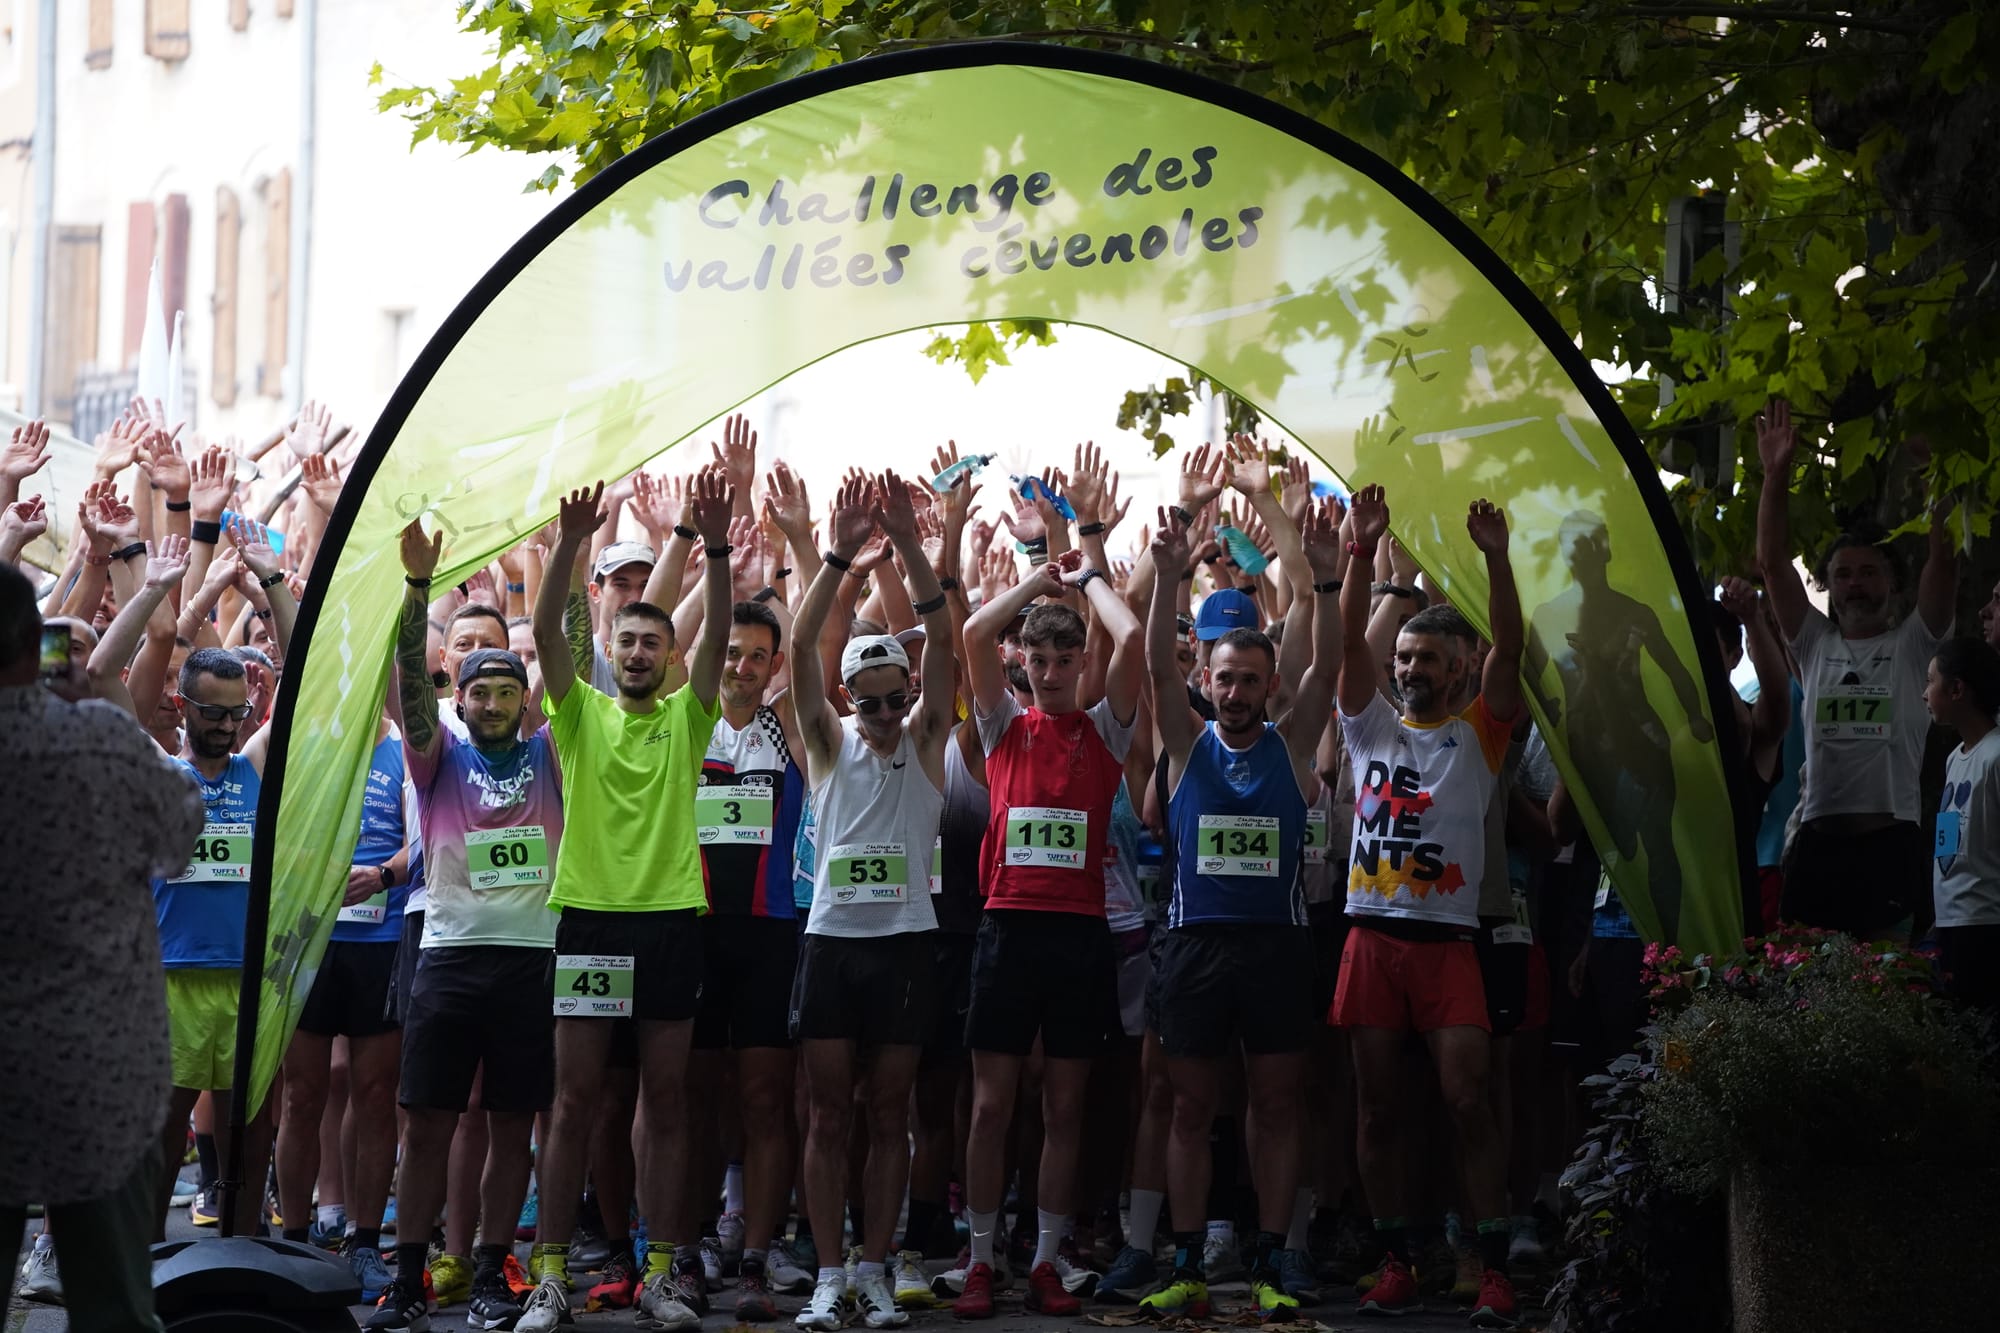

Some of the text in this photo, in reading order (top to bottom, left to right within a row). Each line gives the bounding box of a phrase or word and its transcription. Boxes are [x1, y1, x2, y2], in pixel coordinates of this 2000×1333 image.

[699, 145, 1218, 234] Challenge des
[664, 206, 1263, 292] vallées cévenoles
[1827, 699, 1880, 721] 117
[1362, 760, 1421, 798] DE
[723, 801, 741, 824] 3
[1358, 800, 1421, 839] ME
[1018, 822, 1076, 848] 113
[1210, 831, 1269, 856] 134
[490, 842, 528, 867] 60
[1354, 839, 1445, 881] NTS
[850, 859, 888, 883] 53
[572, 971, 611, 996] 43
